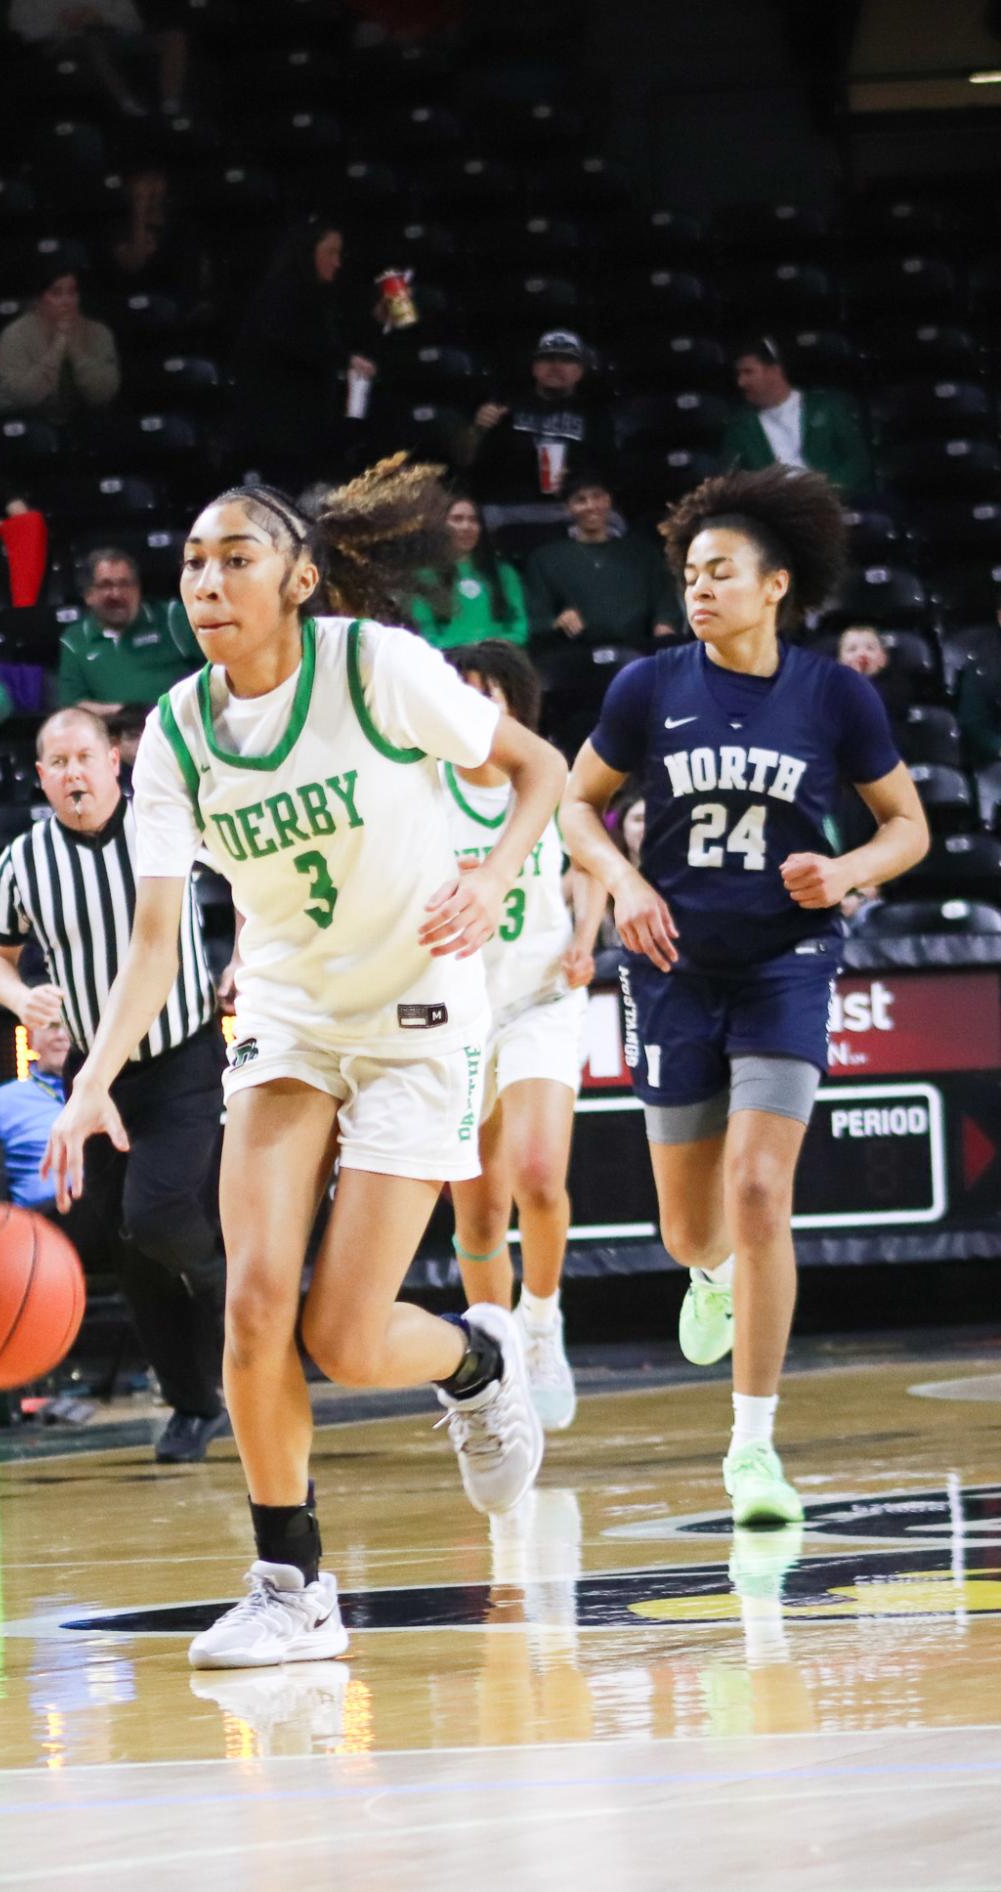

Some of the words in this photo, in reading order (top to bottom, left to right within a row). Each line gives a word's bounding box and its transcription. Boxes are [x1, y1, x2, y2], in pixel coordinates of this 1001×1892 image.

[663, 746, 807, 803] NORTH
[209, 769, 364, 862] DERBY
[687, 803, 767, 871] 24
[293, 850, 338, 930] 3
[431, 1010, 442, 1021] M
[831, 1106, 929, 1138] PERIOD
